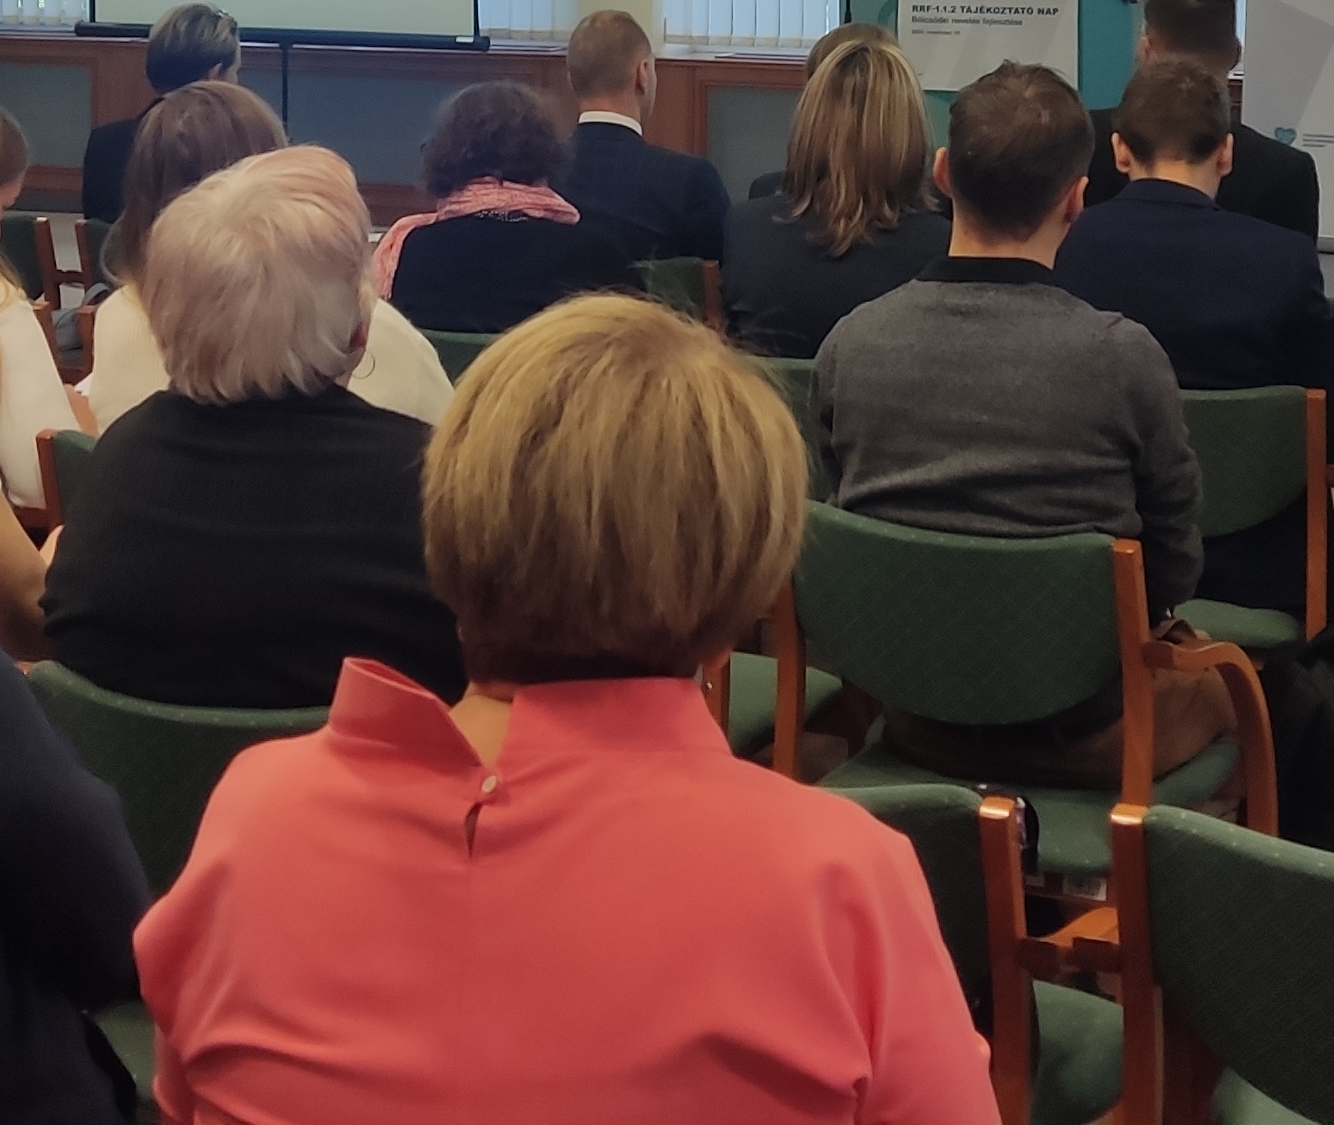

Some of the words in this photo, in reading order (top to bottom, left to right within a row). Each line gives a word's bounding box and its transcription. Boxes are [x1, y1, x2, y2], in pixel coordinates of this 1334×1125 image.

[912, 5, 957, 14] RRF-1.1.2
[960, 5, 1034, 16] TÁJÉKOZTATÓ
[1037, 7, 1059, 16] NAP
